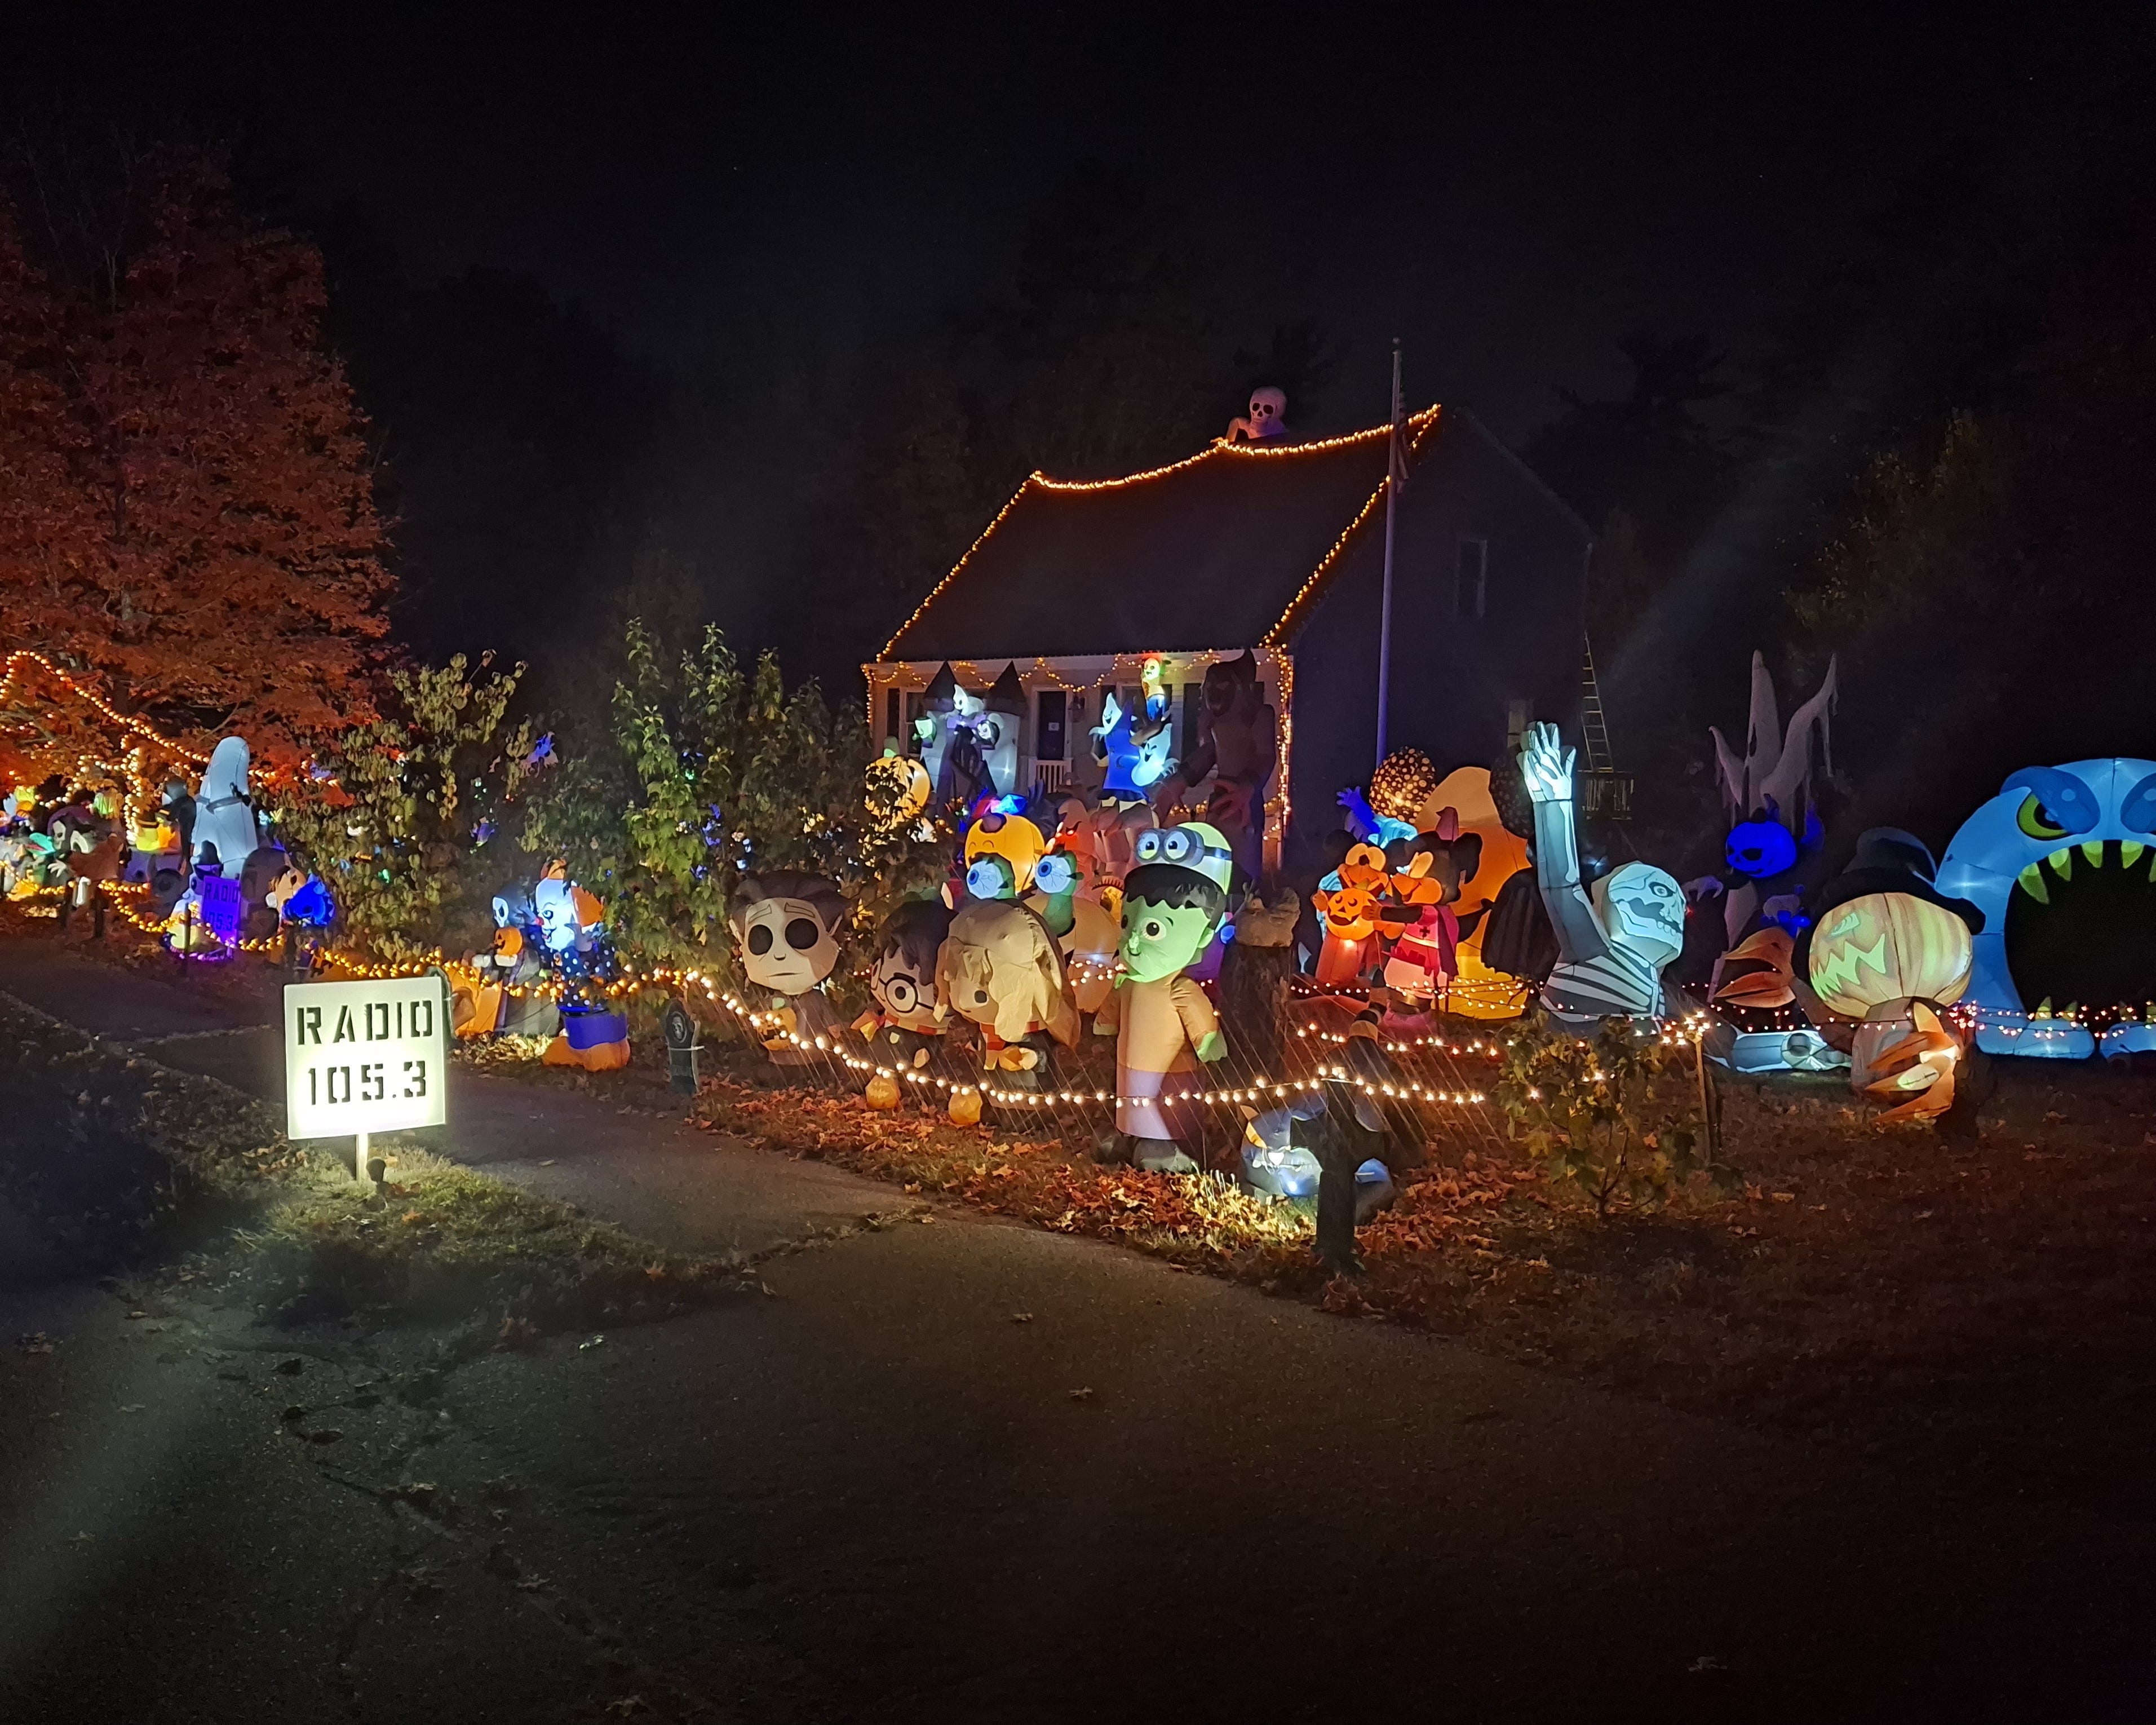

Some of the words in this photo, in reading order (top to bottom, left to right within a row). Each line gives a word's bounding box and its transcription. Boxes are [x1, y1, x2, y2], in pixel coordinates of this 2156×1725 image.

[205, 883, 238, 903] RADIO
[296, 1000, 432, 1045] RADIO
[308, 1060, 426, 1105] 105.3
